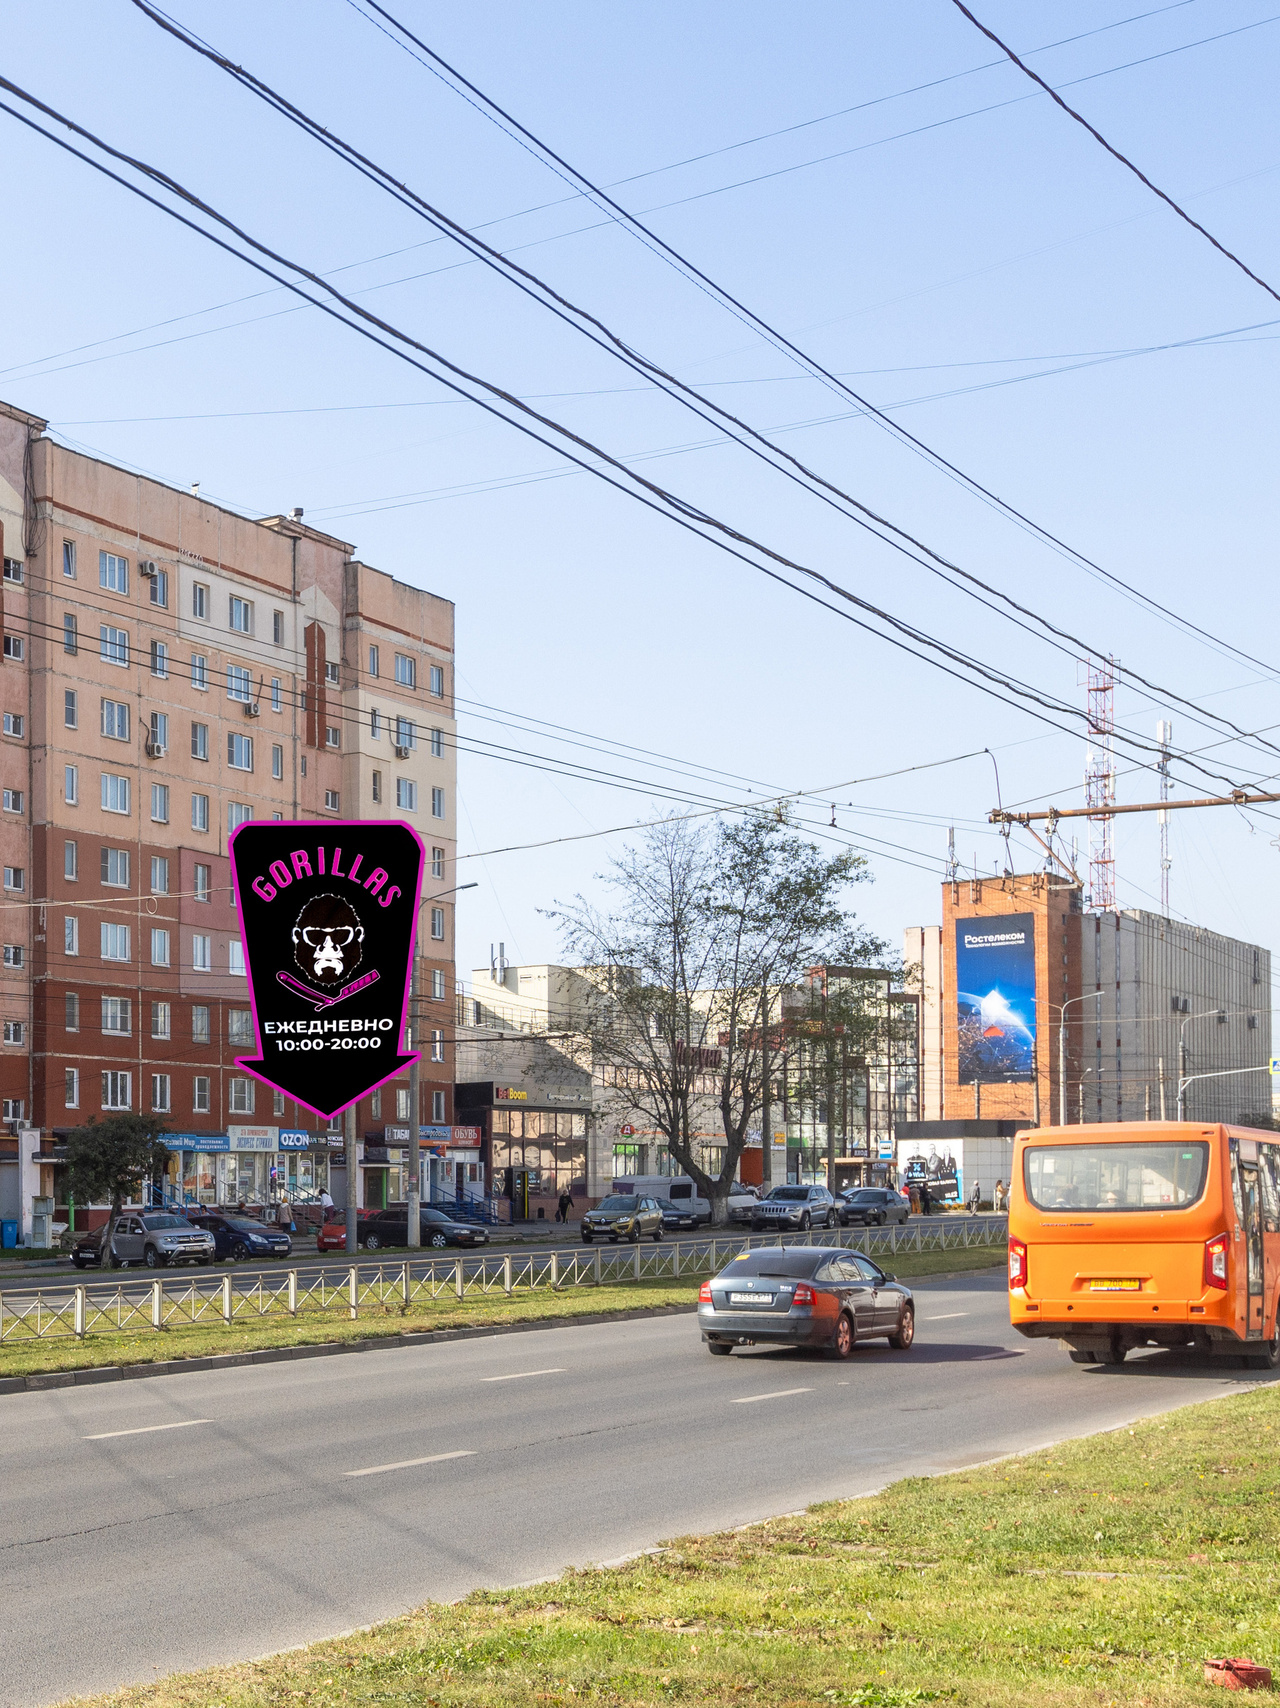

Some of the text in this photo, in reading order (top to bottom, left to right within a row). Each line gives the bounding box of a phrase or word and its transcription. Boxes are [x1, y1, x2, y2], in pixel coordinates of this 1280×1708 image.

[964, 932, 1025, 944] Ростелеком
[496, 1087, 528, 1100] BetBoom
[280, 1133, 310, 1146] OZON
[393, 1129, 410, 1140] ТАБА
[454, 1128, 478, 1139] ОБУВЬ
